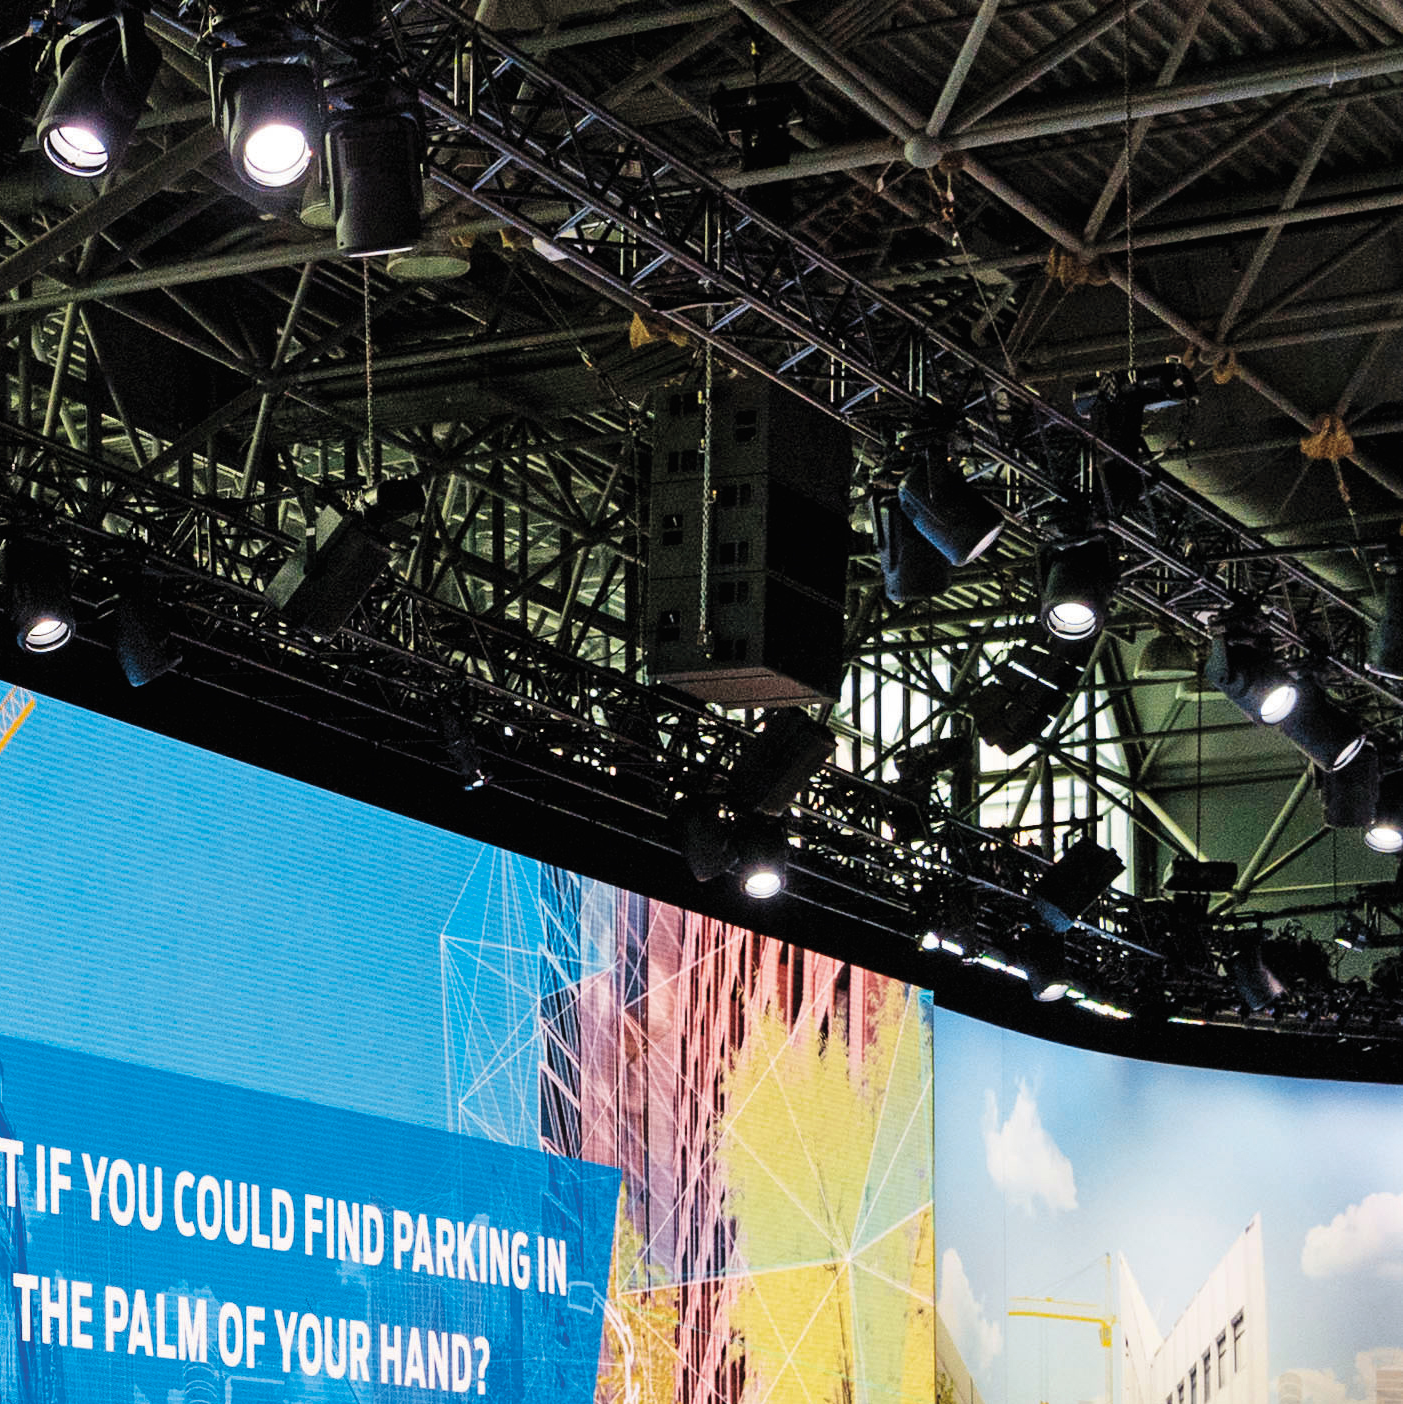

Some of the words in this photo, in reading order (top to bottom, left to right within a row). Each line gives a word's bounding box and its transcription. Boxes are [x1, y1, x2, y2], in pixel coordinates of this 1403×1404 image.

[36, 1144, 71, 1214] IF
[81, 1153, 163, 1231] YOU
[173, 1170, 295, 1251] COULD
[304, 1193, 384, 1266] FIND
[393, 1209, 531, 1290] PARKING
[537, 1235, 567, 1296] IN
[12, 1272, 93, 1350] THE
[104, 1285, 208, 1363] PALM
[218, 1301, 266, 1369] OF
[274, 1309, 370, 1382] YOUR
[379, 1323, 491, 1396] HAND?
